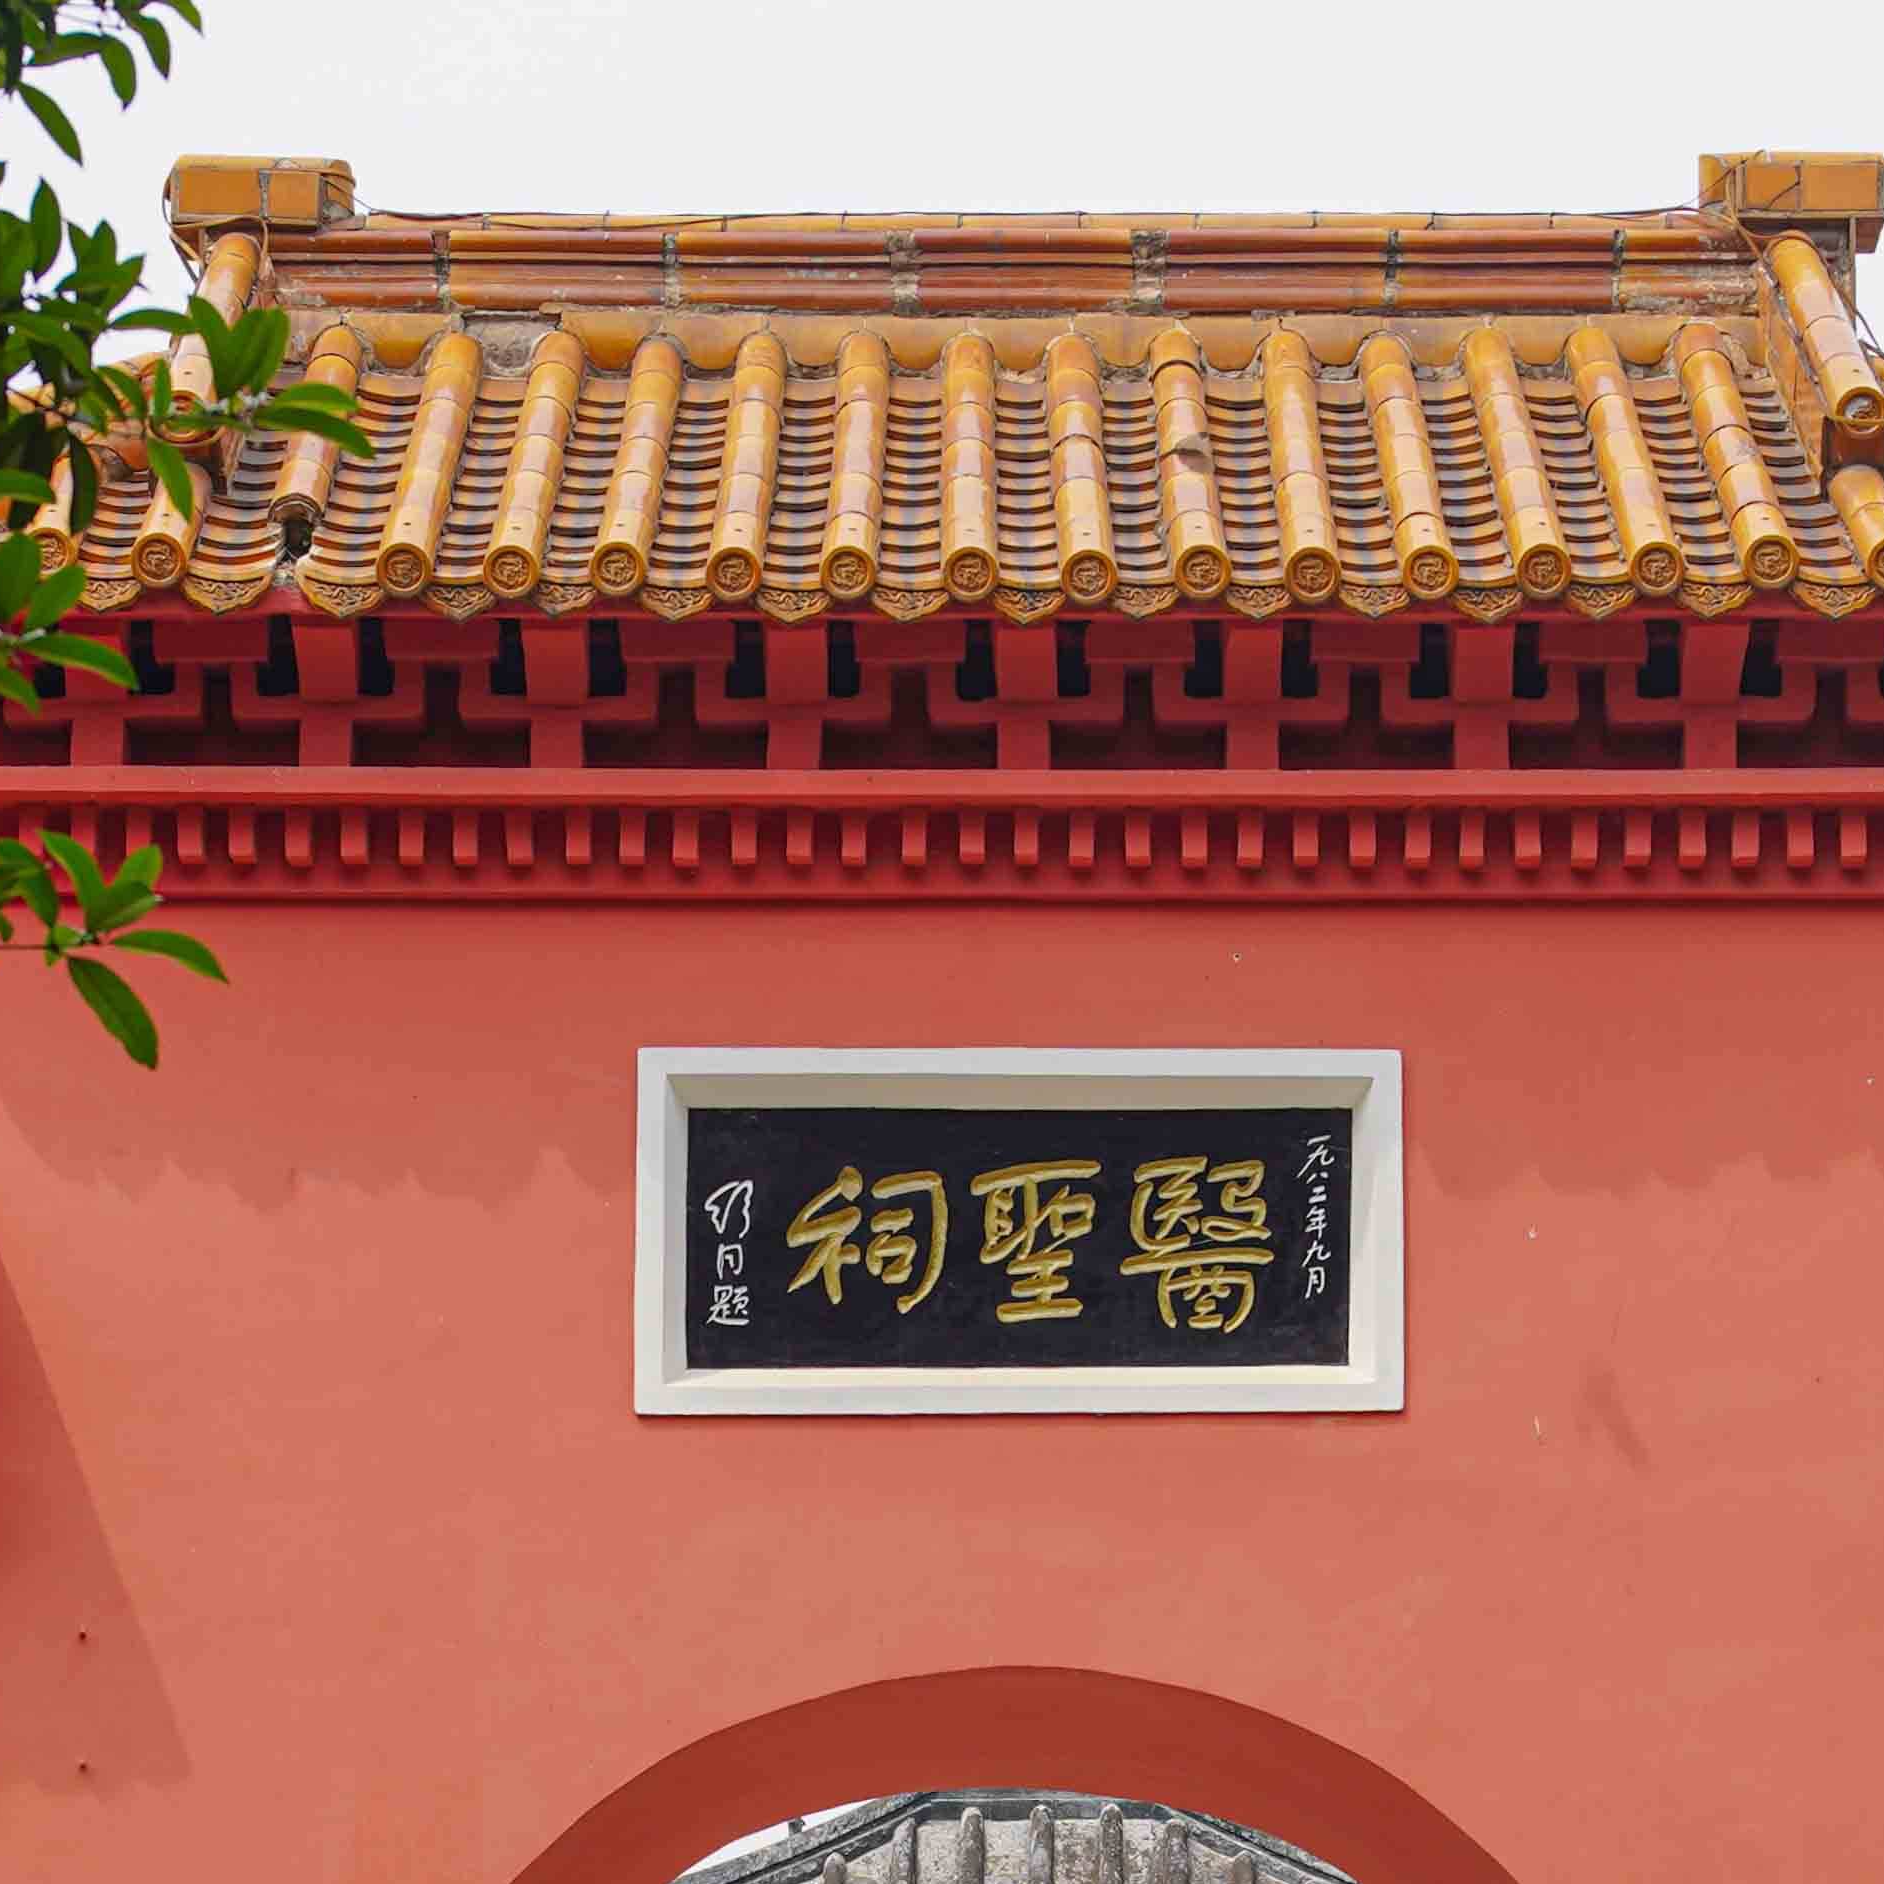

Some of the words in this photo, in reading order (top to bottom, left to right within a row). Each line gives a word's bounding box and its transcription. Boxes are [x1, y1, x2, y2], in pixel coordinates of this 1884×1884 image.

[1296, 1134, 1335, 1303] 一九八二年九月
